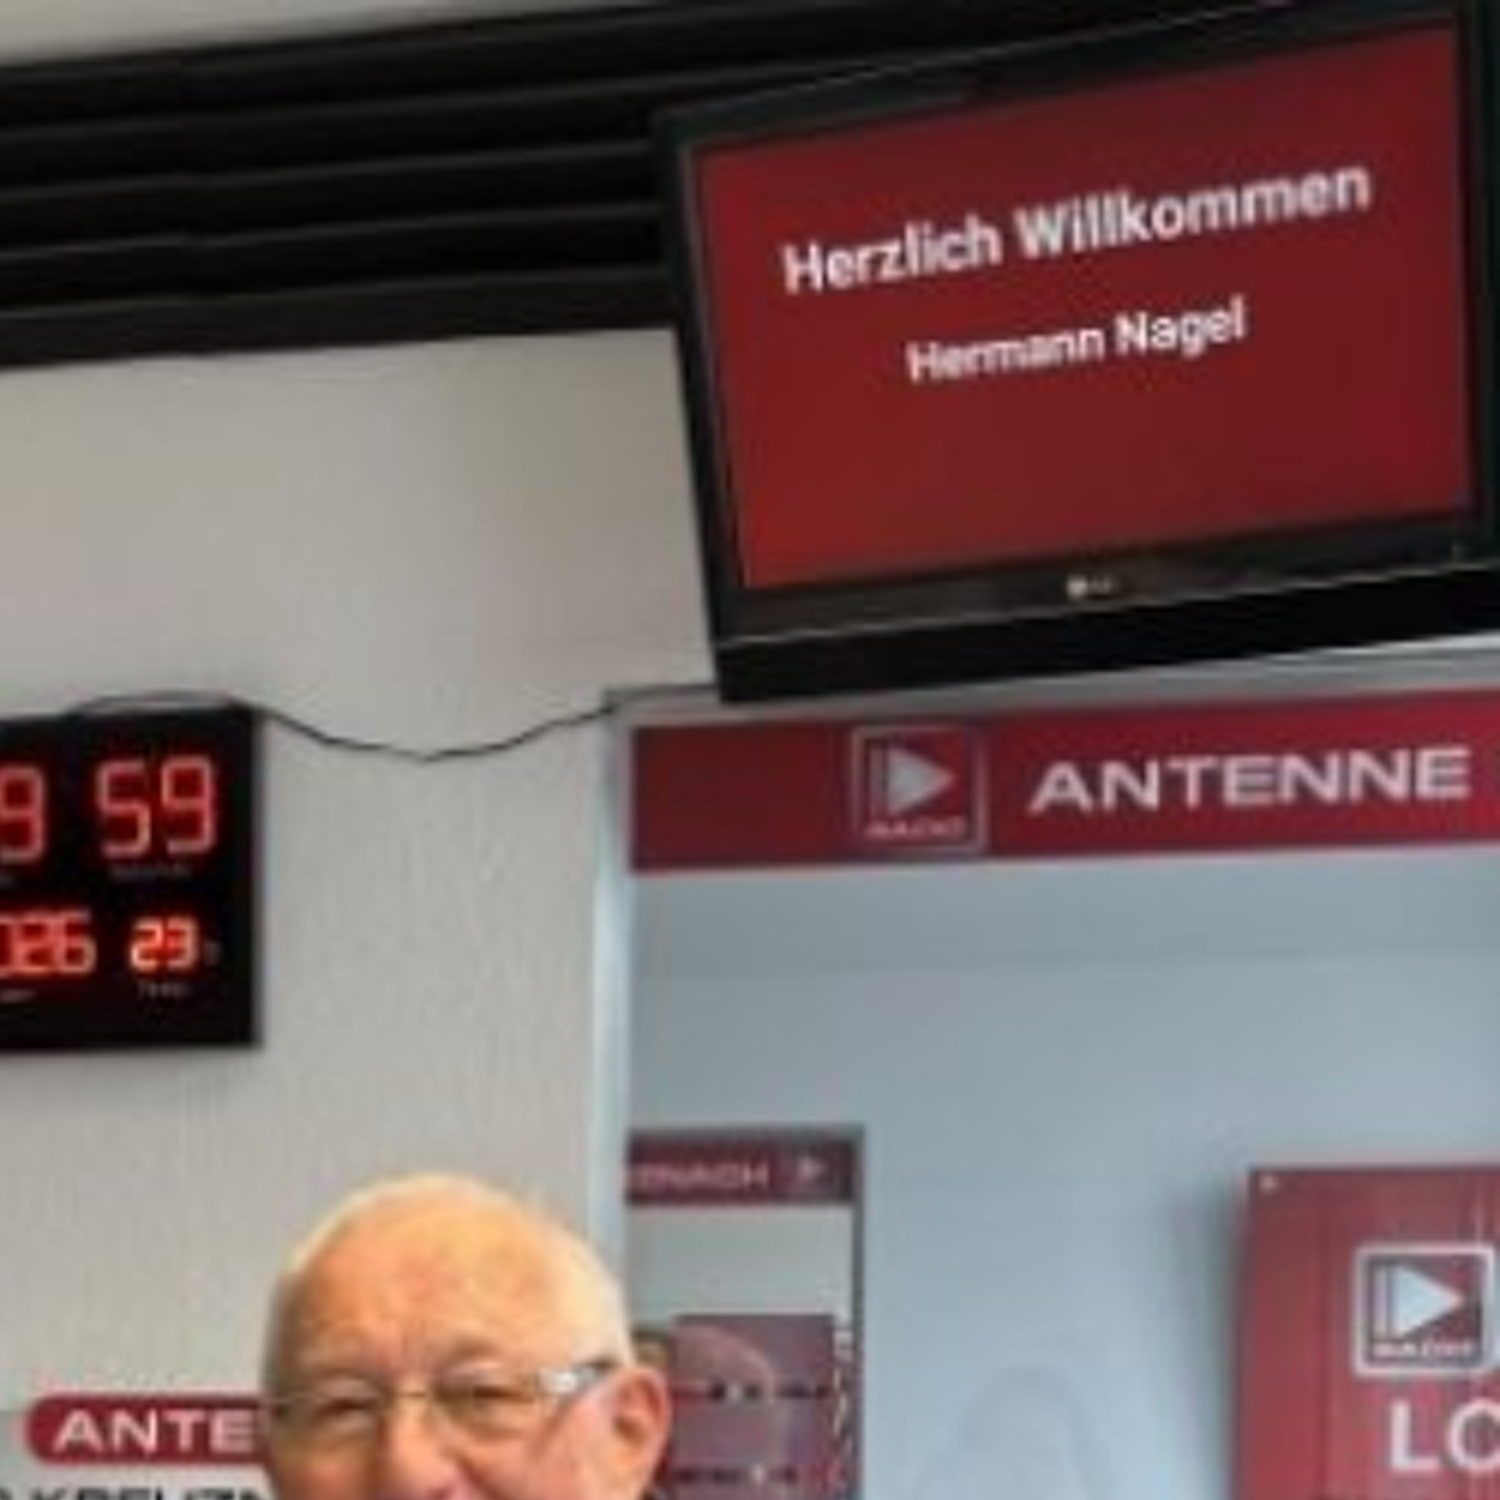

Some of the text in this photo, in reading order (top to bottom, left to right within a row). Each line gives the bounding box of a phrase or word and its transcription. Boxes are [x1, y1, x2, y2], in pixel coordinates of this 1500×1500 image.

[781, 164, 1373, 295] Herzlich Willkommen
[905, 296, 1247, 384] Hermann Nagel
[97, 756, 215, 856] 59
[1026, 745, 1472, 816] ANTENNE
[129, 916, 201, 971] 23
[52, 1407, 258, 1454] ANTE
